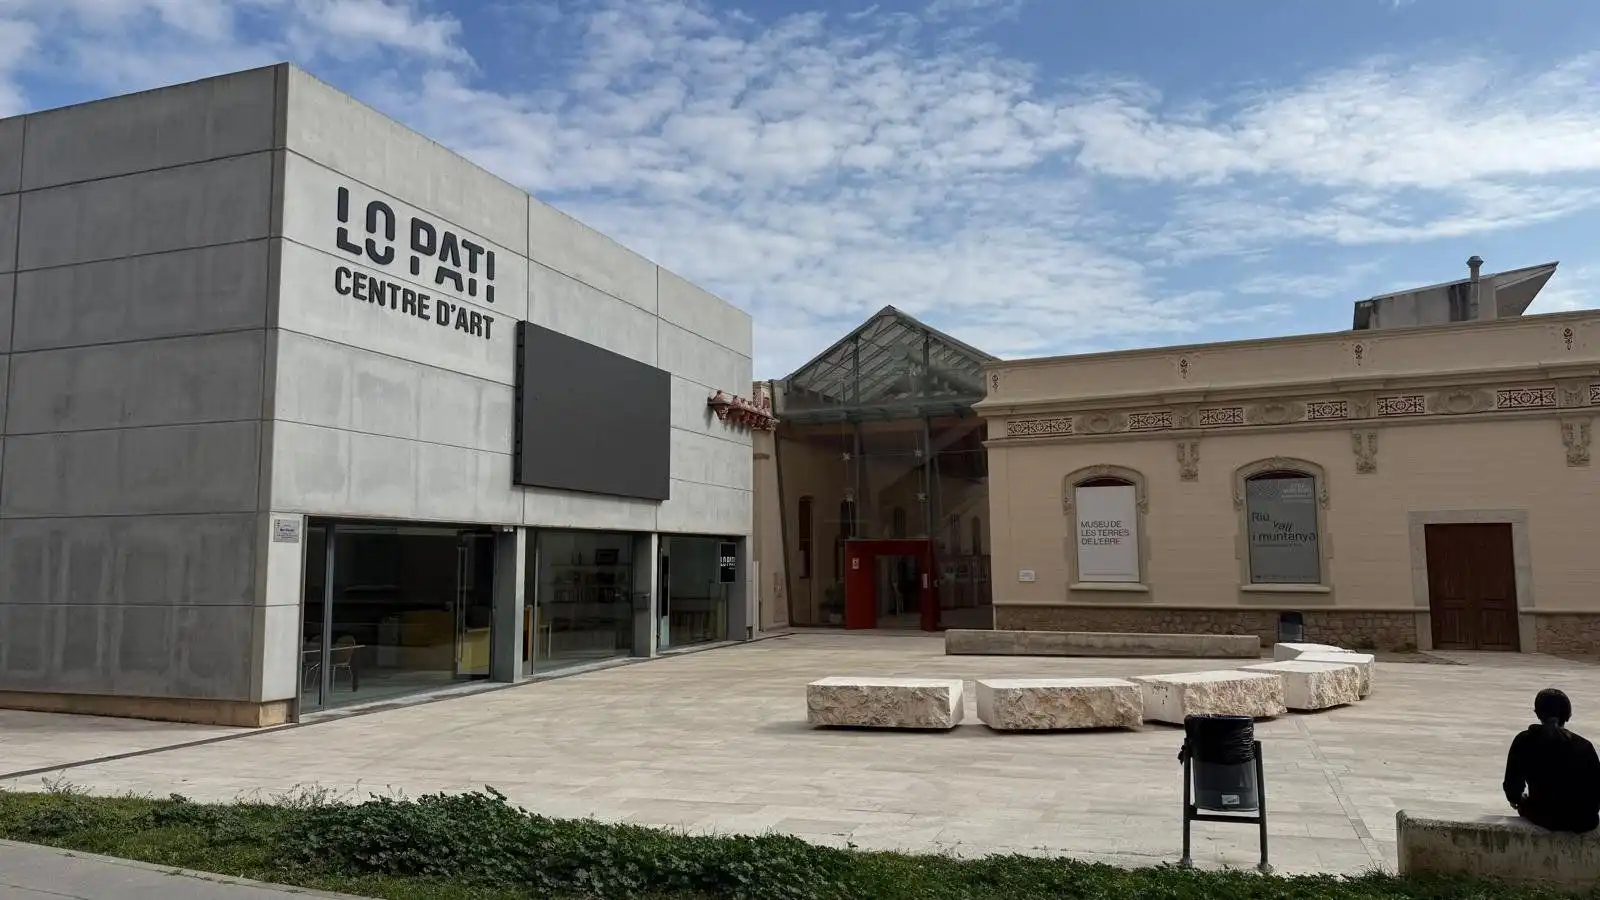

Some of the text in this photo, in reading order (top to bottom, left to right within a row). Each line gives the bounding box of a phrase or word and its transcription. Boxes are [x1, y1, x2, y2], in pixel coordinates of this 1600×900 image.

[337, 186, 495, 303] LO PATI
[335, 266, 495, 340] CENTRE D'ART
[1081, 520, 1122, 528] MUSEU DE
[1081, 529, 1130, 537] LES TERRES
